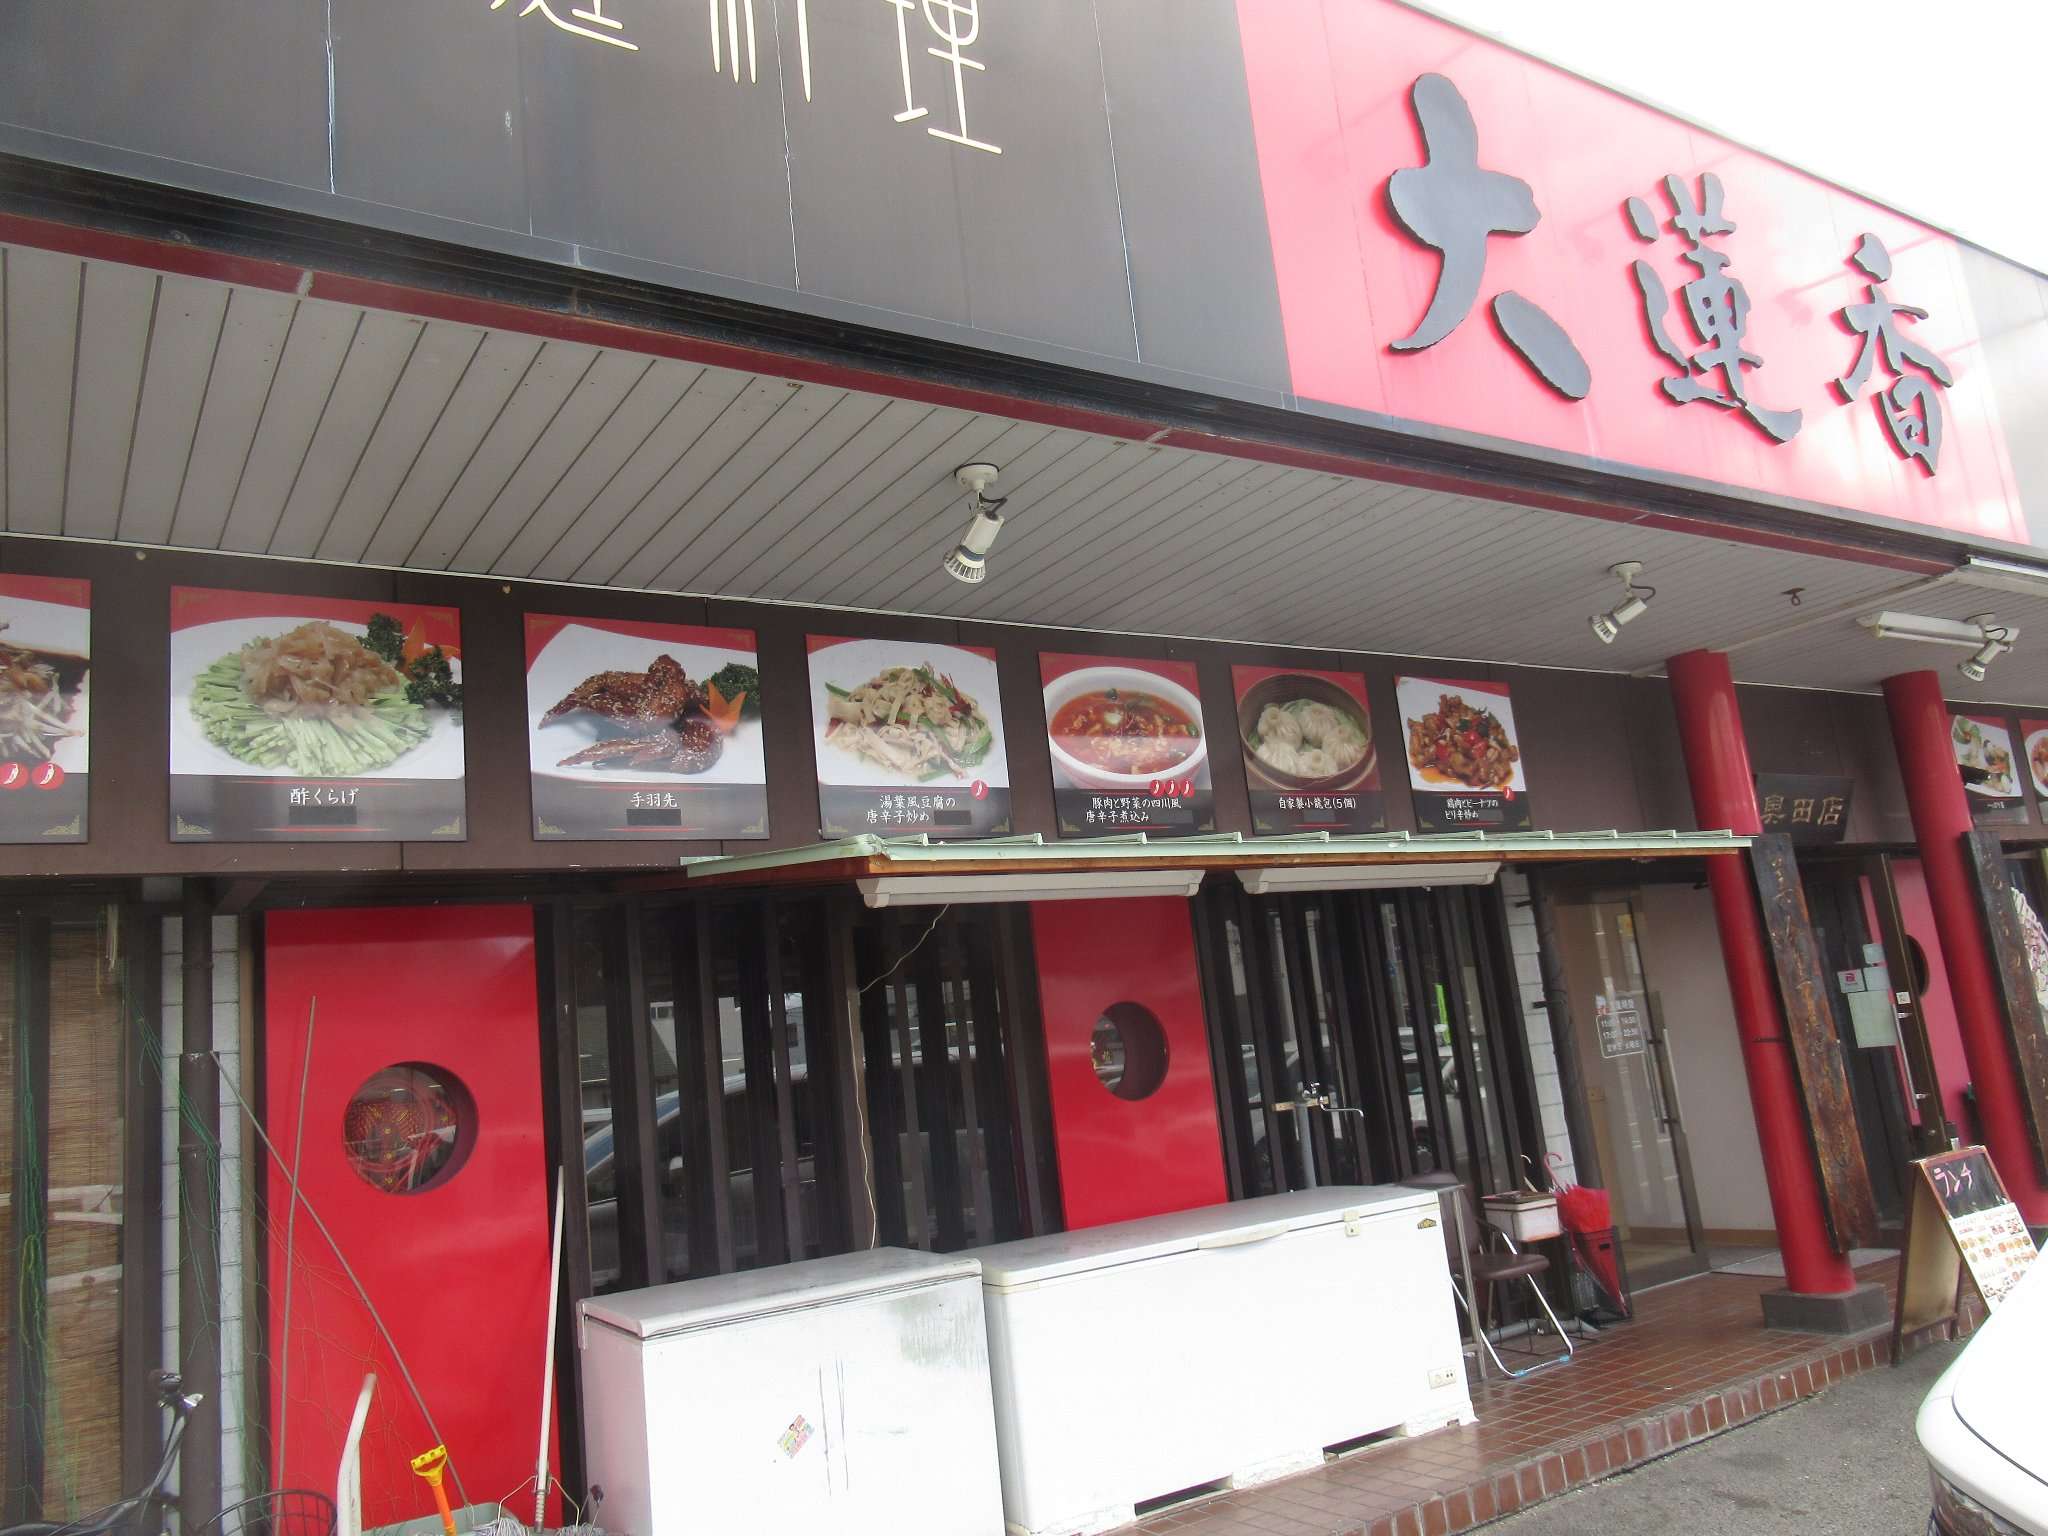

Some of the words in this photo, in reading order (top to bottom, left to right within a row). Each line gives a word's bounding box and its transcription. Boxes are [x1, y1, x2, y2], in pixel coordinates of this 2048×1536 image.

[1386, 72, 1953, 477] 大蓮香
[290, 787, 359, 805] 酢くらげ
[631, 792, 678, 807] 手羽先
[880, 794, 956, 810] 湯葉風豆腐の
[1092, 797, 1181, 809] 豚肉と野菜の四川風
[866, 809, 929, 824] 唐辛子炒め
[1086, 810, 1149, 823] 唐辛子煮込み
[1934, 1160, 1973, 1198] ランチ
